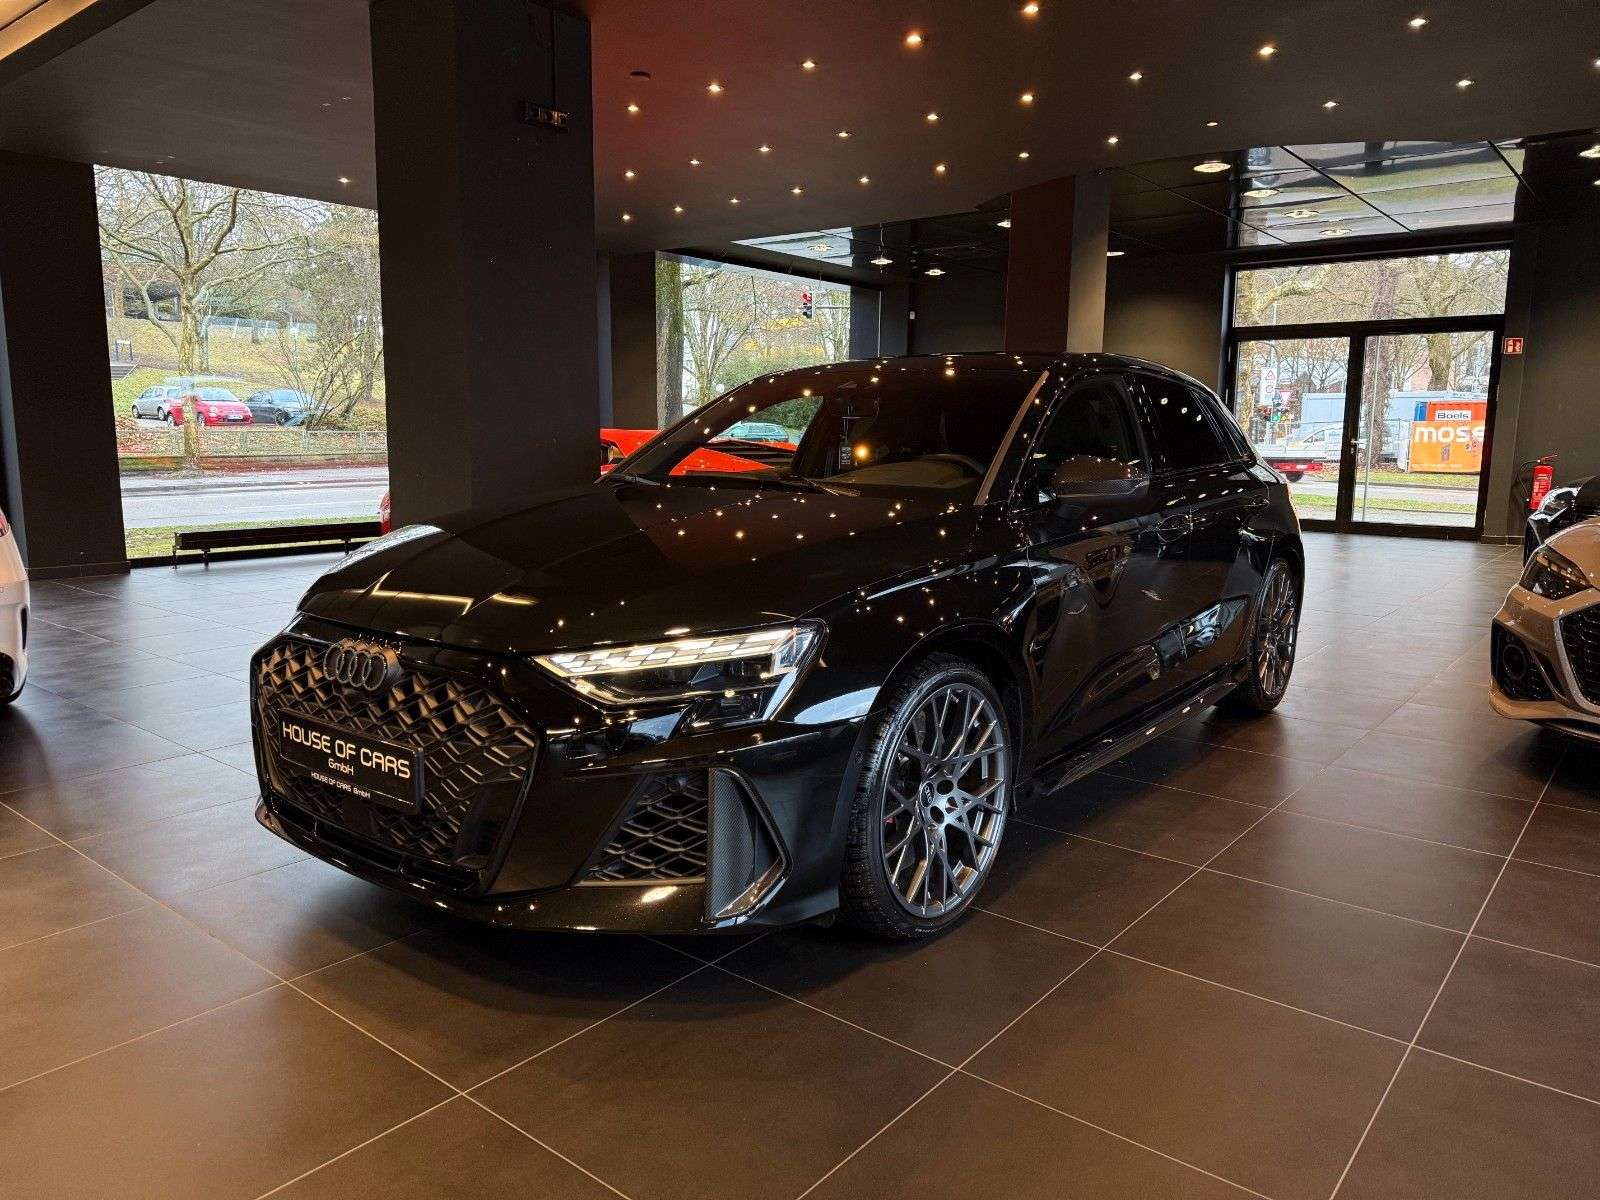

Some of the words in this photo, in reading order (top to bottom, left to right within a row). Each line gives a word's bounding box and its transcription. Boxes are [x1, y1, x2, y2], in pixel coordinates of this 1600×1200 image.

[282, 721, 331, 753] HOUSE
[335, 740, 356, 760] OF
[360, 748, 410, 779] CARS
[328, 758, 354, 776] GmbH
[311, 771, 328, 784] HOUSE
[328, 778, 336, 786] OF
[336, 781, 352, 792] CARS
[353, 787, 371, 799] GmbH
